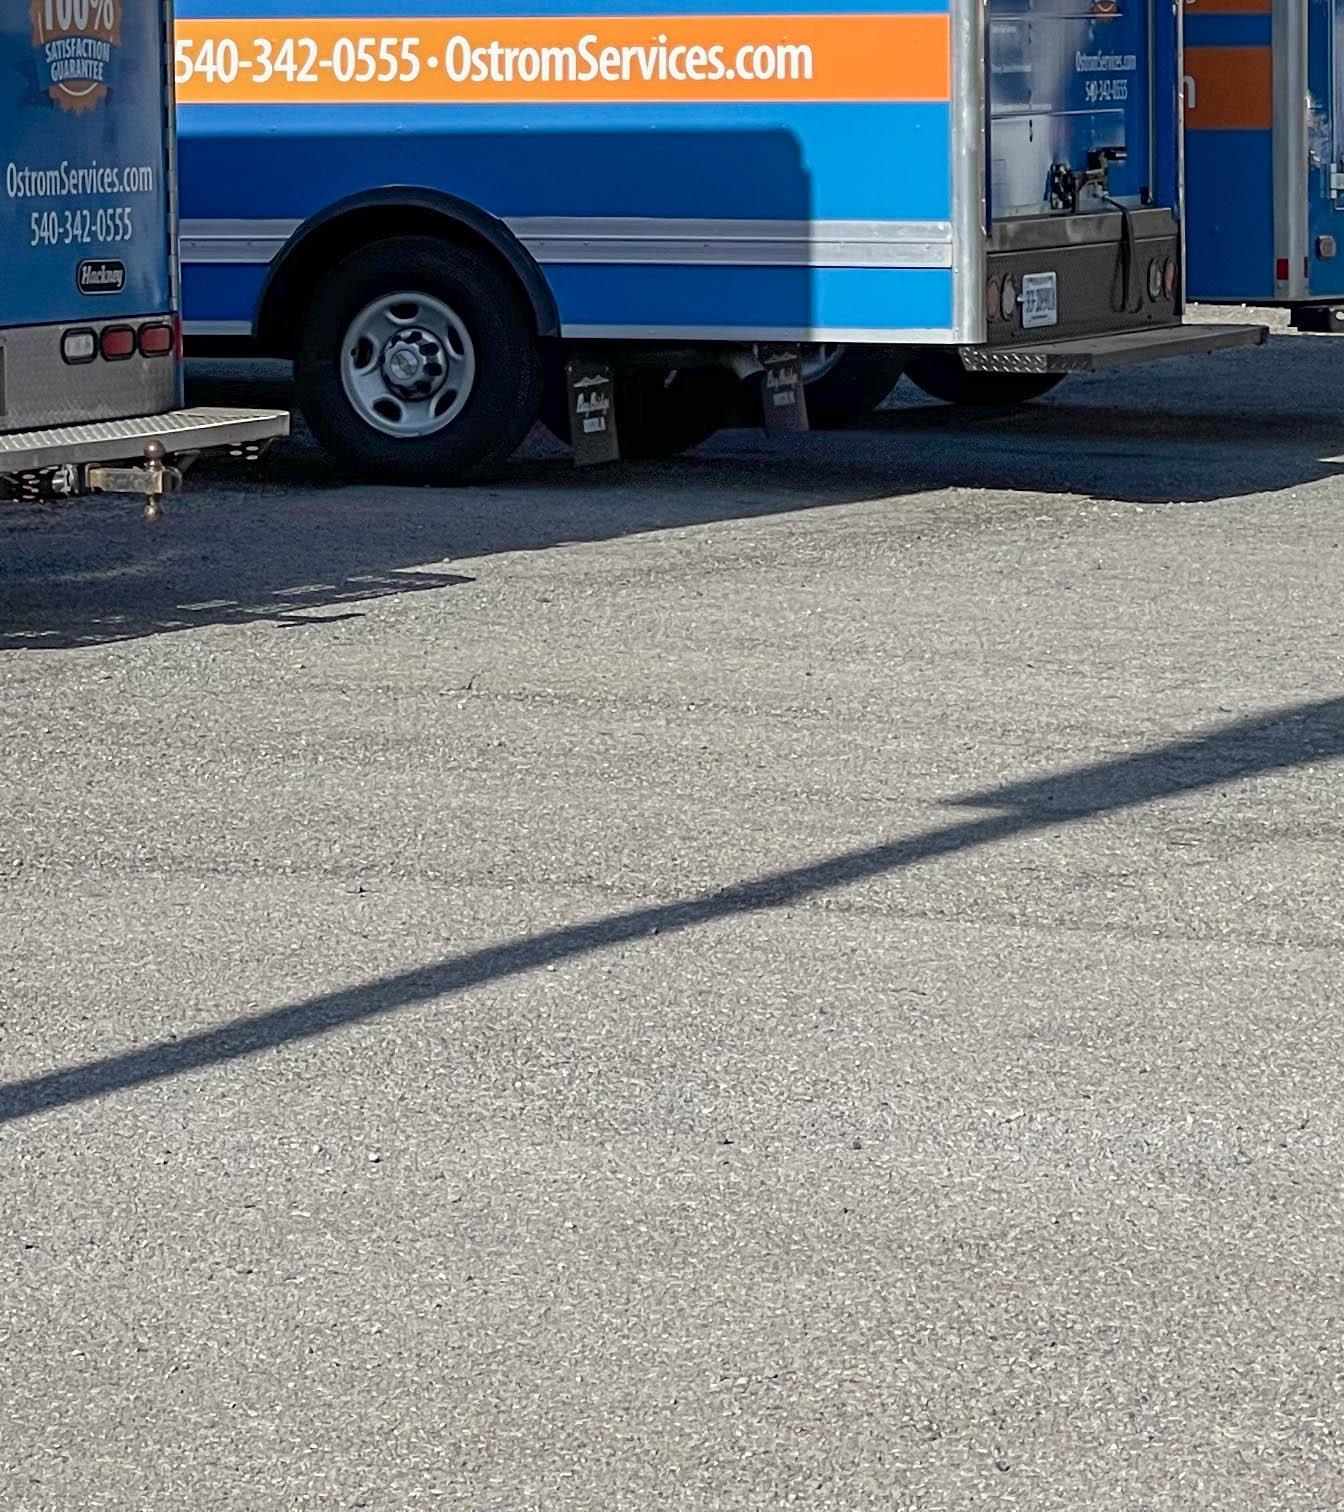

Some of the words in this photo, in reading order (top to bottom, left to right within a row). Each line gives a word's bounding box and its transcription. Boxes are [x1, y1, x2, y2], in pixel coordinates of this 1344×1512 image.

[45, 38, 110, 63] SATISFACTION
[175, 37, 420, 83] 540-342-0555
[445, 34, 813, 82] OstromServices.com
[51, 60, 104, 81] GUARANTEE
[7, 160, 153, 198] OstromServices.com
[31, 207, 132, 246] 540-342-0555
[81, 265, 123, 288] Hackney
